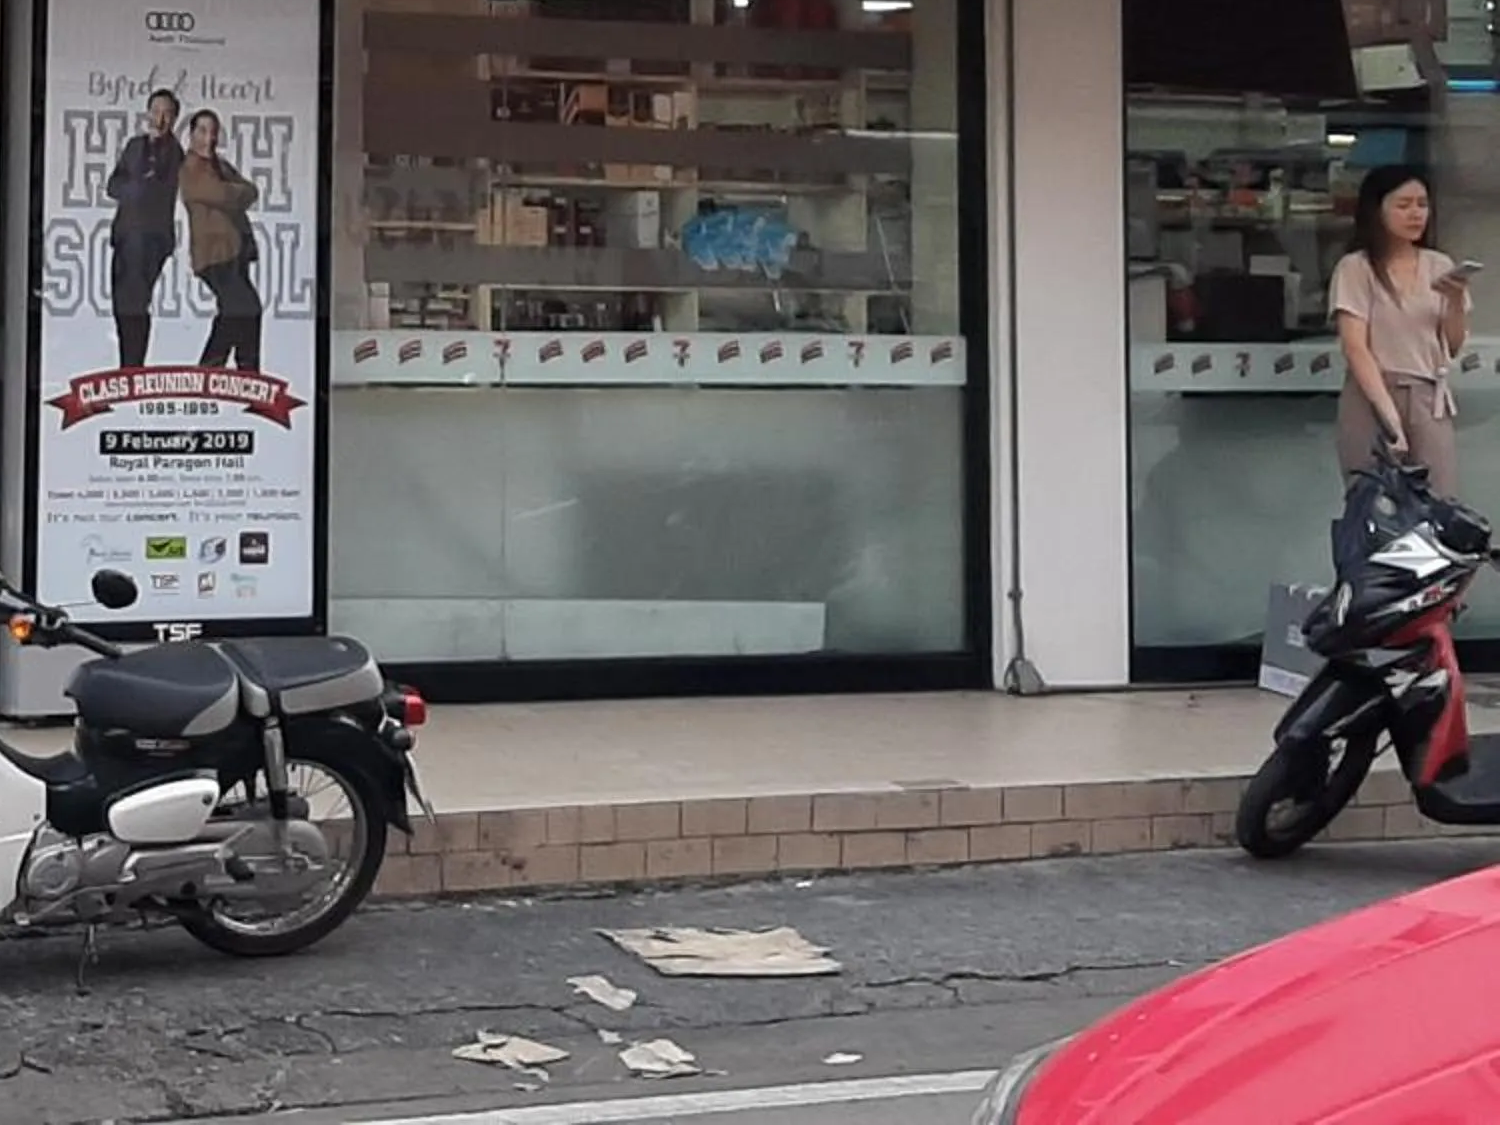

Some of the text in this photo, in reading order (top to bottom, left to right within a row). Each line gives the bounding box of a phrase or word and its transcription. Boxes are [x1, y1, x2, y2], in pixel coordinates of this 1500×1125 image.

[89, 64, 159, 104] Byrd
[202, 75, 276, 104] Heart
[79, 372, 280, 404] CLASS REUNION CONCERT
[104, 432, 250, 452] 9 February 2019
[109, 455, 246, 472] Royal Paragon Hall
[152, 622, 204, 642] TSF
